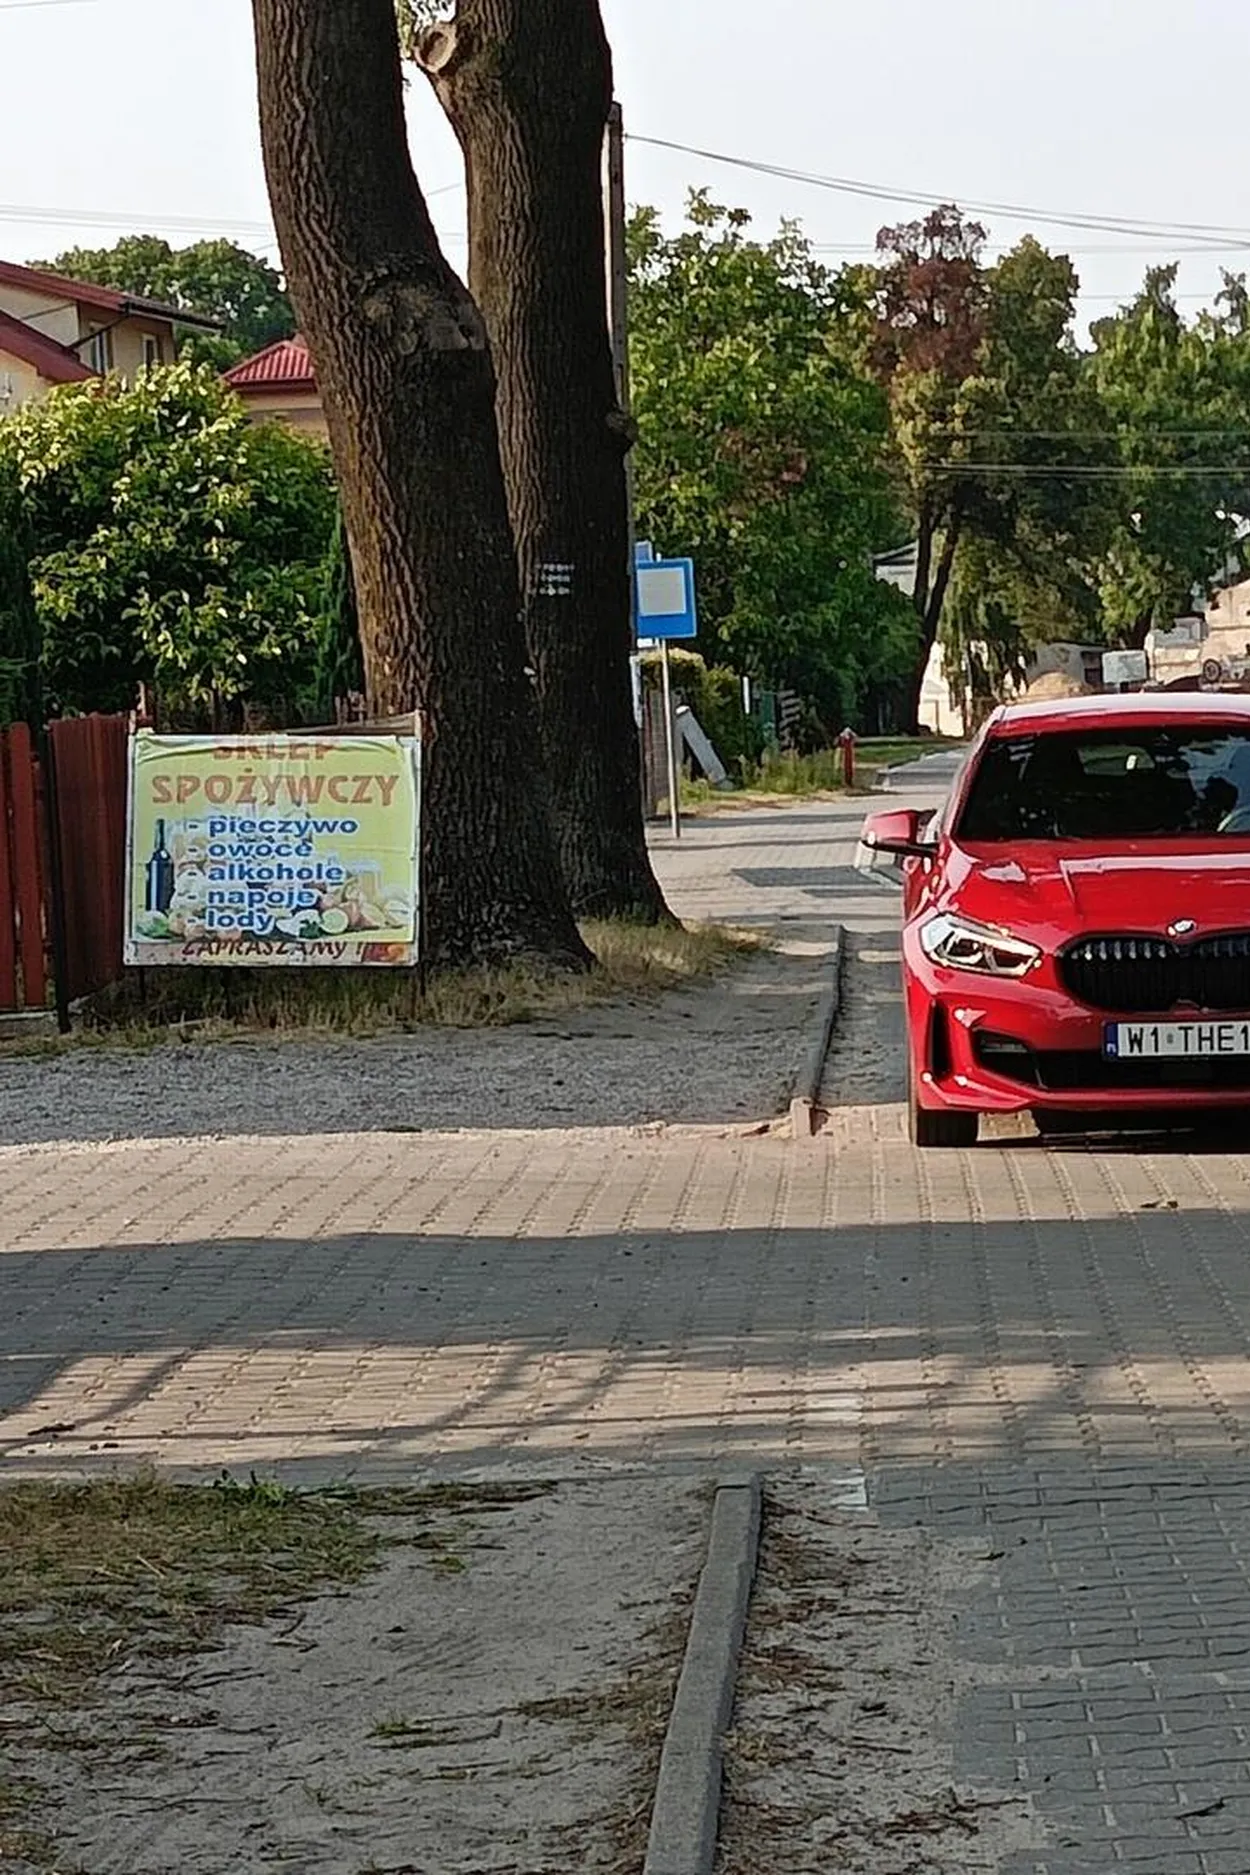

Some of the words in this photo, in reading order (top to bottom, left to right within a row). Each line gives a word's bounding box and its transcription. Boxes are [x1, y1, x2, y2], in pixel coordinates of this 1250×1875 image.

[151, 768, 399, 806] SPOŻYWCZY
[208, 818, 358, 837] pieczywo
[208, 843, 313, 857] owoce
[208, 863, 343, 880] alkohole
[208, 887, 315, 907] napoje
[208, 910, 273, 930] lody
[1127, 1026, 1159, 1053] W1
[1178, 1025, 1249, 1052] THE1
